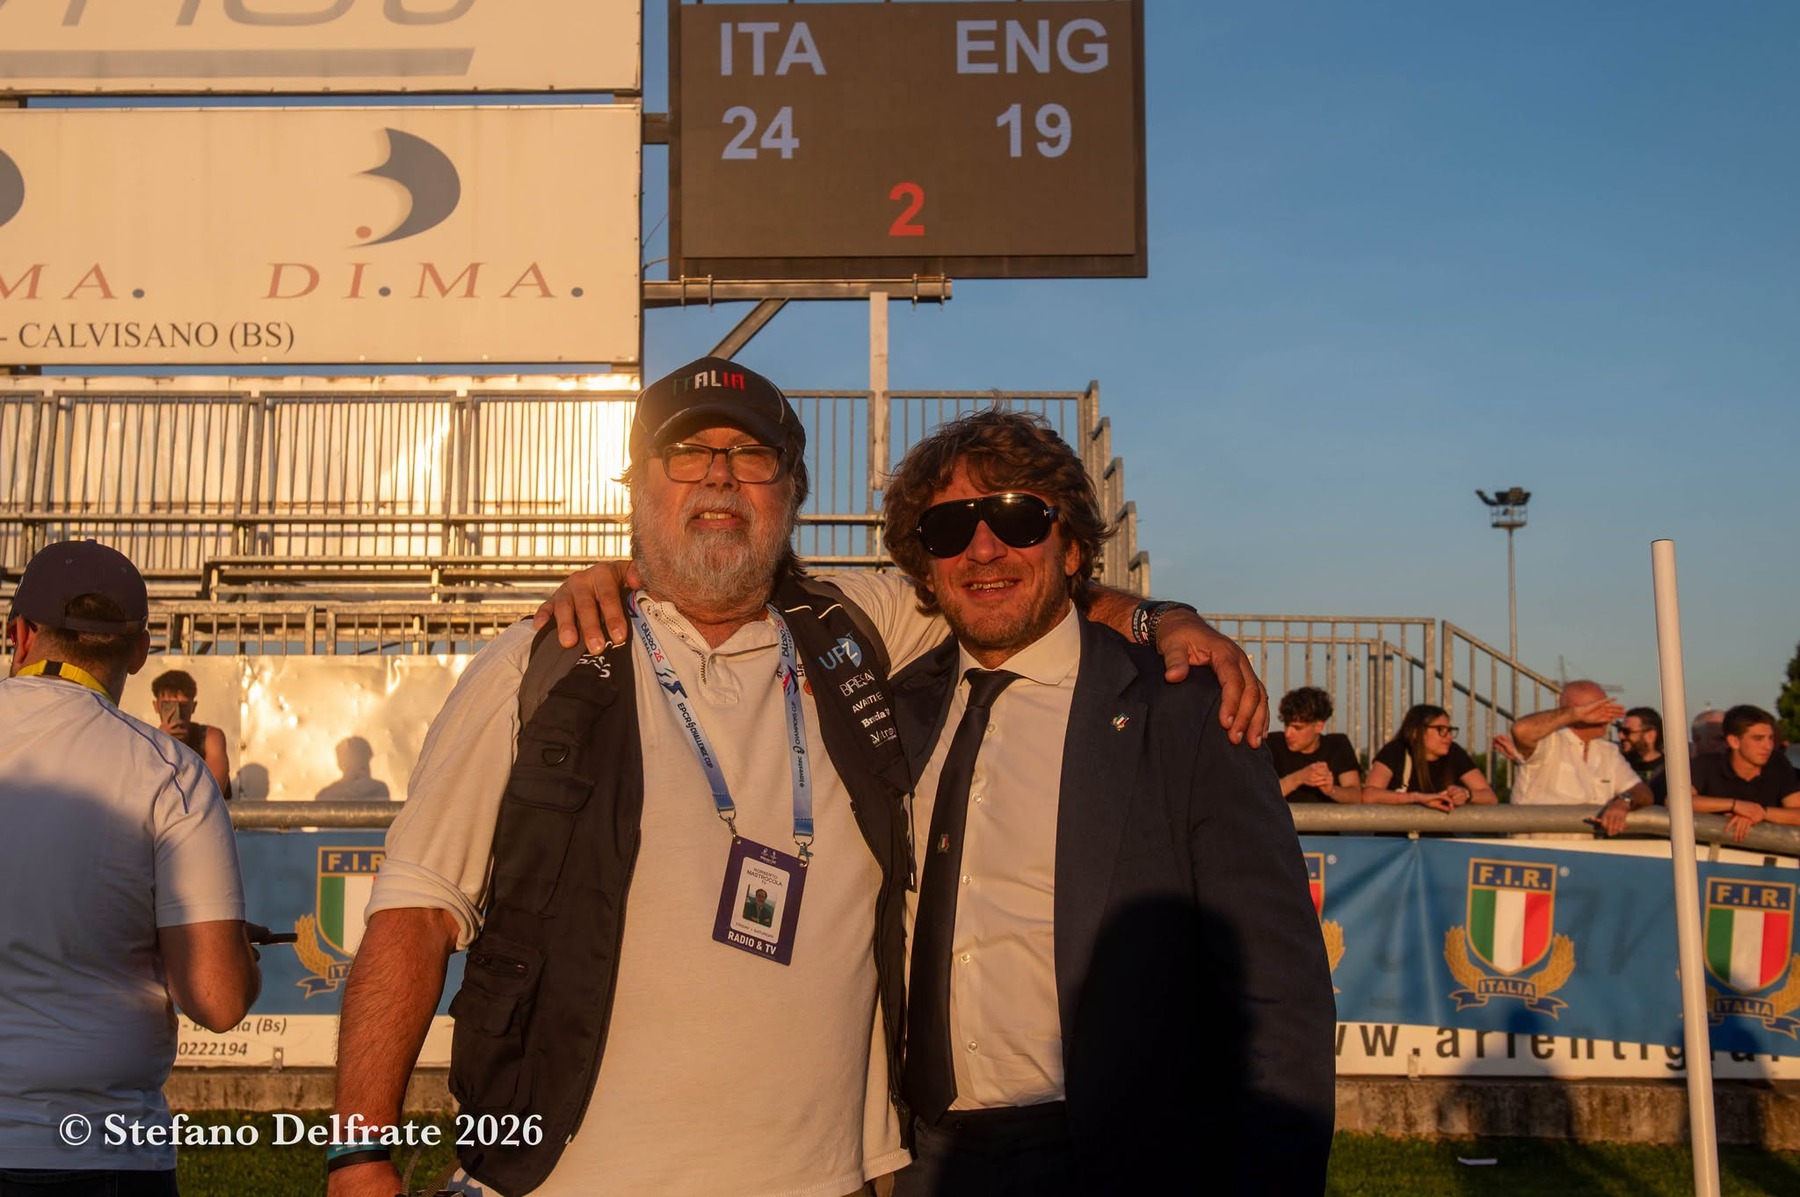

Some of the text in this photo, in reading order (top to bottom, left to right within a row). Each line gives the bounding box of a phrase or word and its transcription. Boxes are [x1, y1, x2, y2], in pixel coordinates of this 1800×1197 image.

[720, 18, 1109, 76] ITA ENG
[721, 103, 1073, 159] 24 19
[888, 182, 925, 236] 2
[18, 322, 218, 349] CALVISANO
[229, 322, 294, 353] (BS)
[672, 370, 745, 396] ITALIA
[677, 702, 691, 724] EPCR
[1478, 865, 1548, 888] F.I.R.
[1716, 885, 1787, 908] F.I.R.
[727, 930, 777, 955] RADIO & TV
[1480, 979, 1535, 997] ITALIA
[1716, 999, 1773, 1017] ITALIA
[256, 1017, 287, 1036] (Bs)
